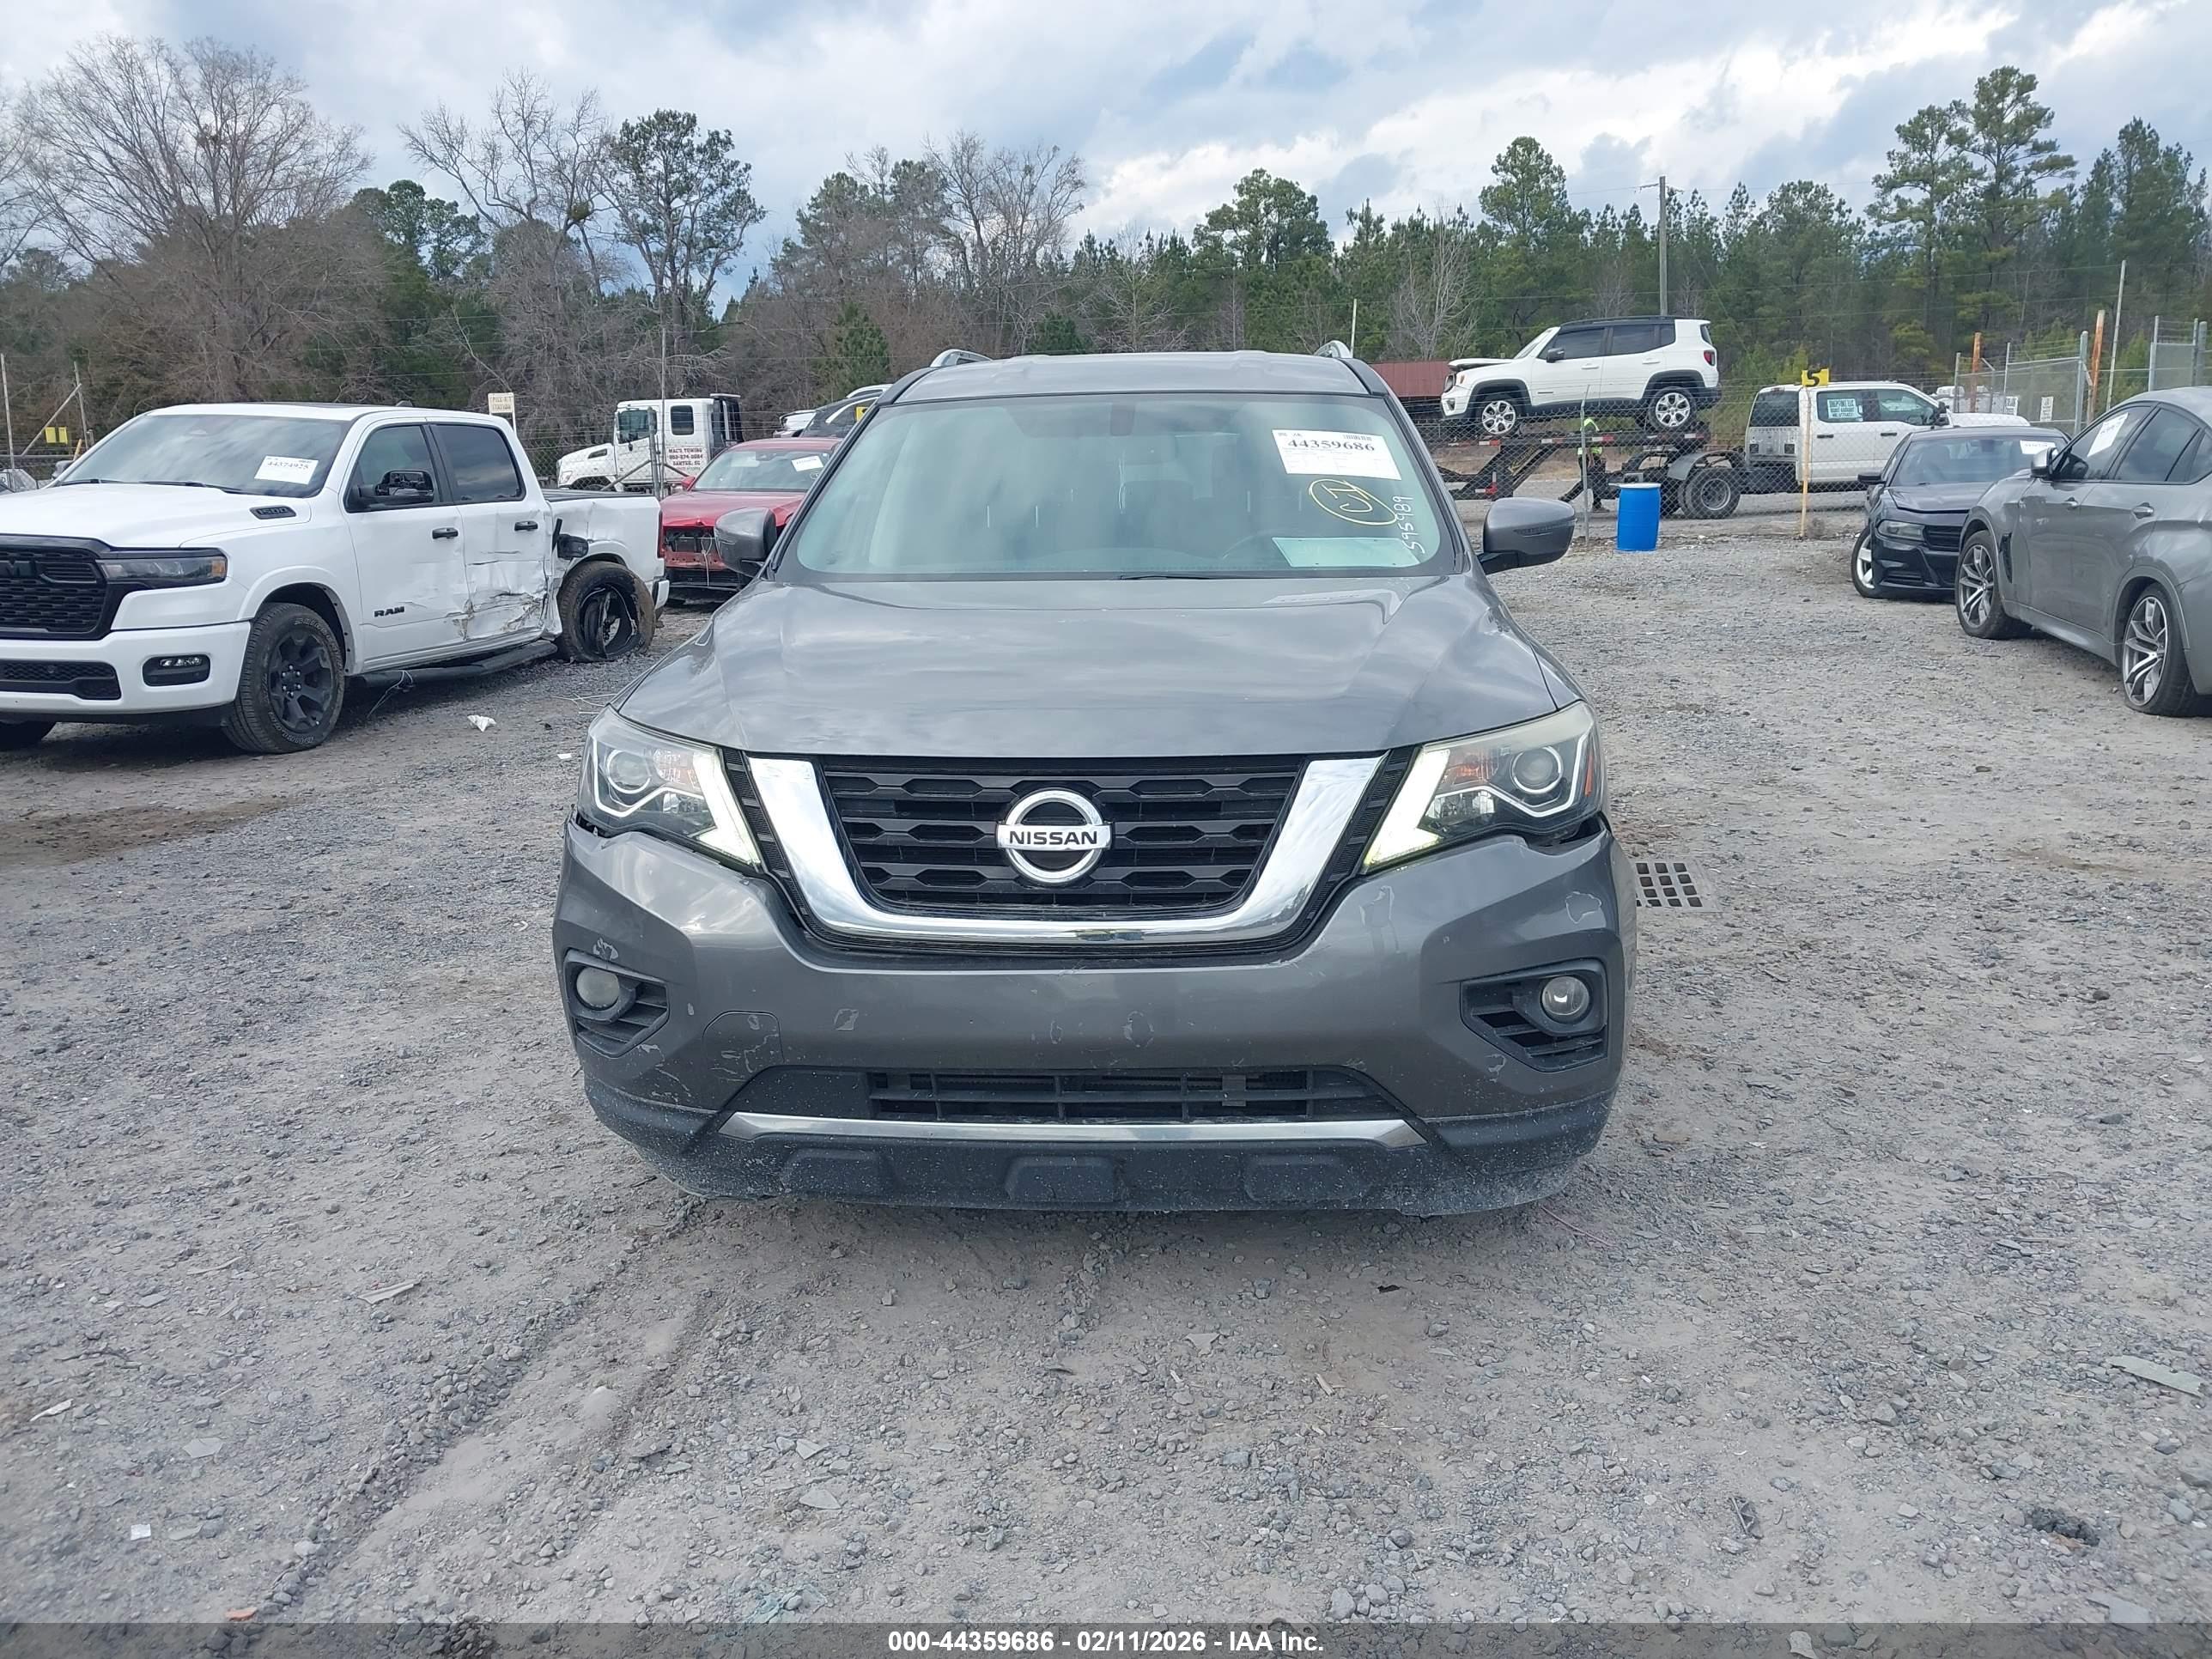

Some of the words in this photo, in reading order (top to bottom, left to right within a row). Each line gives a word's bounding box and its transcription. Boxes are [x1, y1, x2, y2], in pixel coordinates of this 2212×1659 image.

[1806, 369, 1821, 387] 5
[1288, 439, 1375, 452] 44359686
[374, 605, 405, 617] RAM
[1009, 830, 1097, 845] NISSAN
